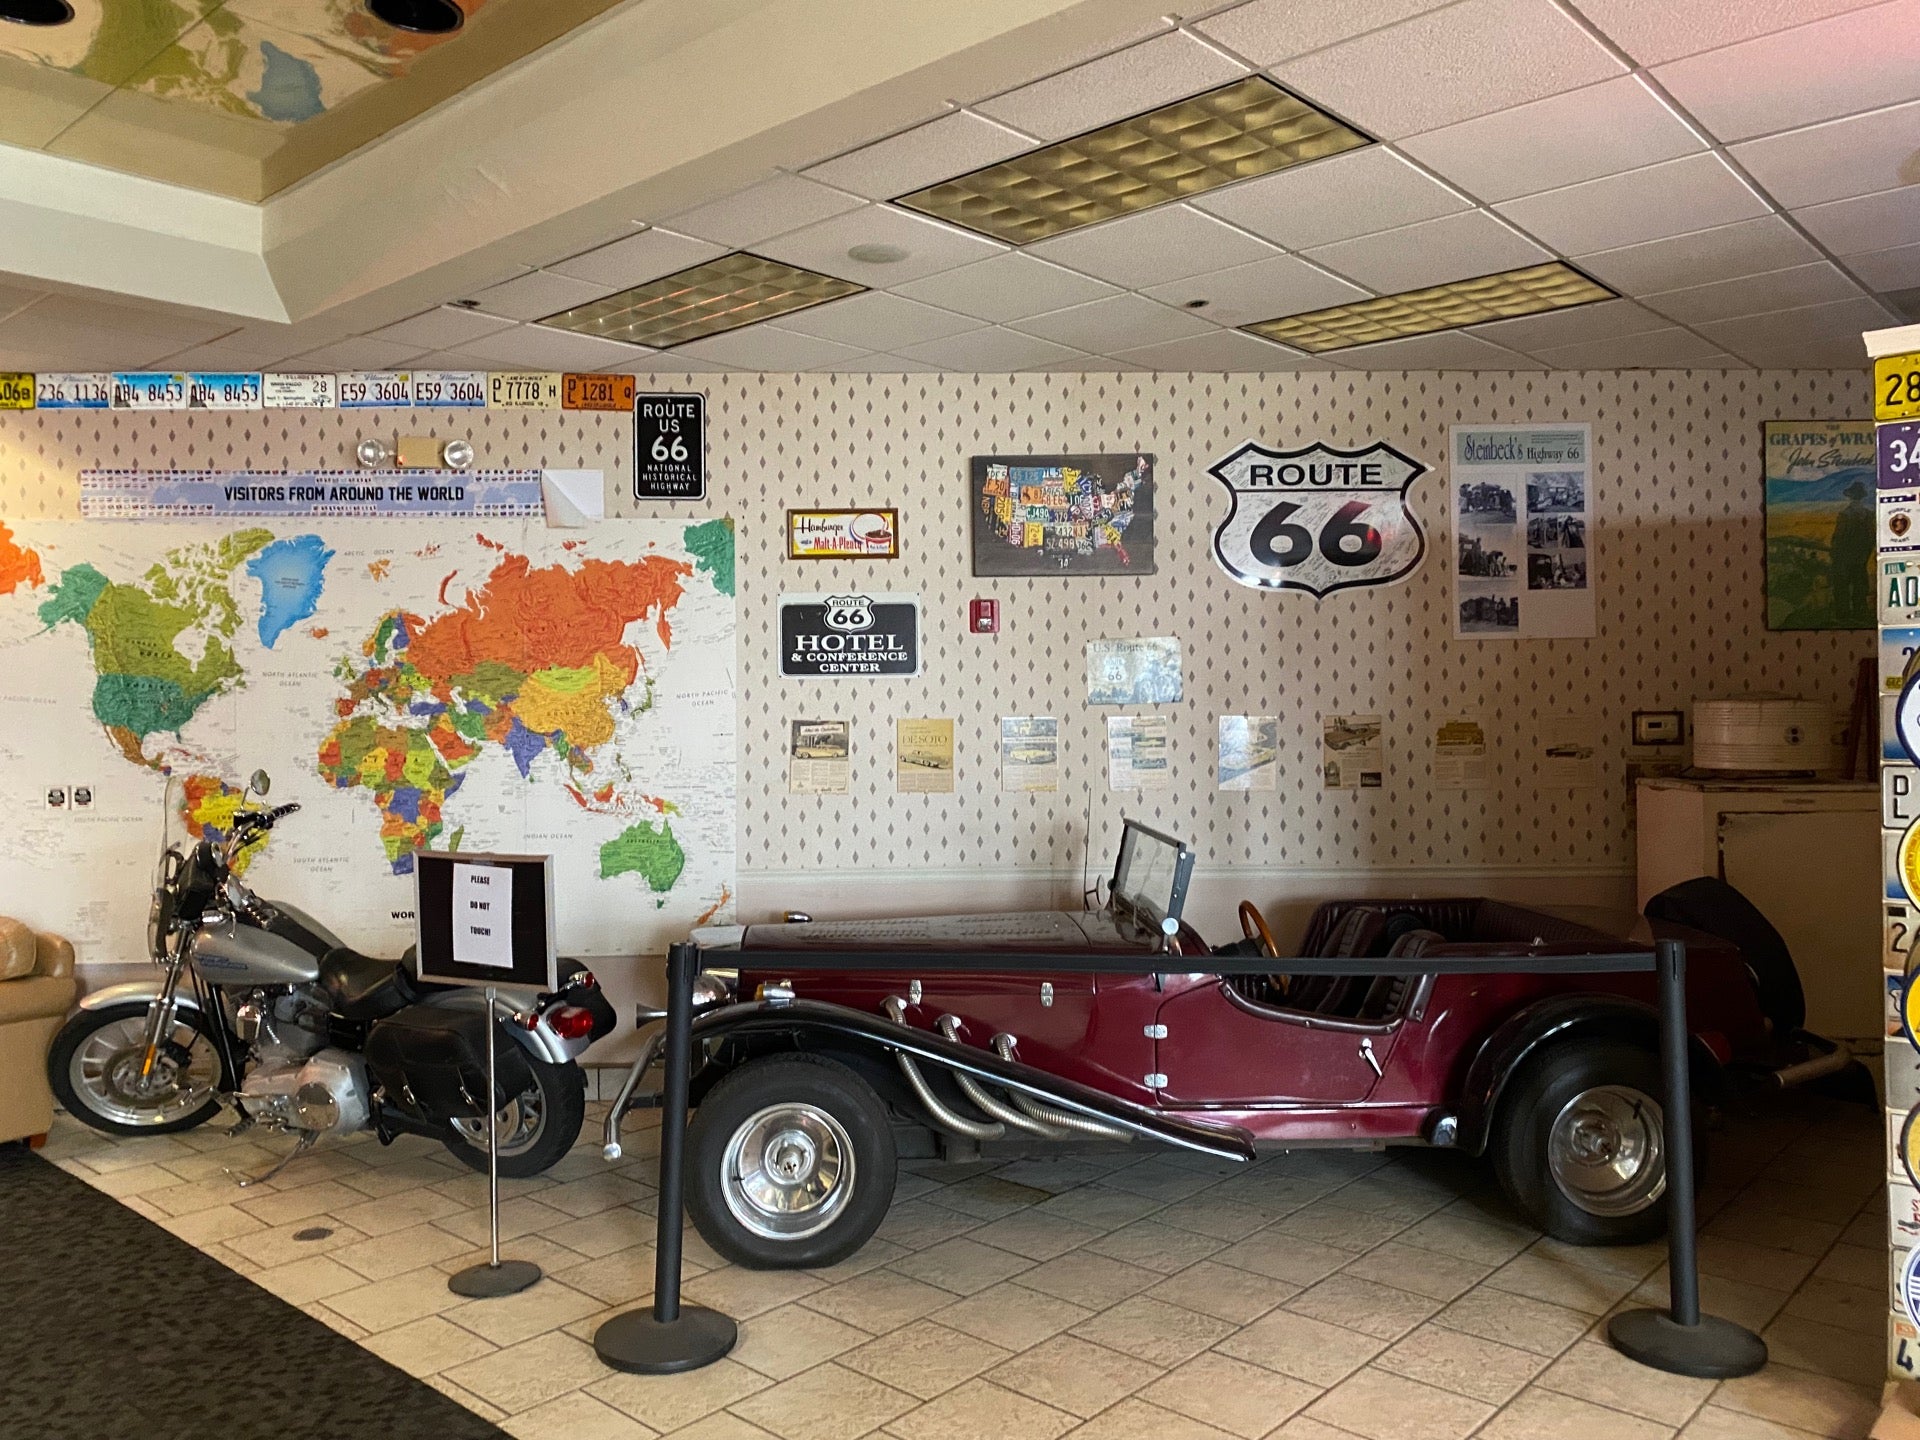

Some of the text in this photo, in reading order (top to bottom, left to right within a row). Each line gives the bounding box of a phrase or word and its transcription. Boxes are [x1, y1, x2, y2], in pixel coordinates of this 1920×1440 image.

[0, 382, 30, 401] 06B
[38, 383, 108, 401] 236 1136
[148, 384, 182, 401] 8453
[224, 384, 257, 401] 8453
[312, 380, 327, 392] 28
[341, 382, 408, 400] E59 3604
[416, 382, 483, 400] E59 3604
[506, 381, 539, 400] 7778
[549, 384, 556, 398] H
[582, 382, 614, 401] 1281
[643, 403, 695, 418] ROUTE
[659, 418, 680, 433] US
[1769, 433, 1827, 445] GRAPES
[1840, 433, 1876, 445] WRA
[651, 435, 688, 462] 66
[1464, 434, 1523, 460] Steinbeck's
[1527, 447, 1563, 464] Highway
[1567, 447, 1580, 459] 66
[647, 464, 691, 472] NATIONAL
[1250, 464, 1382, 486] ROUTE
[642, 473, 697, 481] HISTORICAL
[224, 486, 464, 501] VISITORS FROM AROUND THE WORLD
[650, 482, 690, 490] HIGHWAY
[1250, 501, 1382, 567] 66
[833, 609, 864, 625] 66
[795, 634, 903, 651] HOTEL
[791, 652, 908, 662] & CONFERENCE
[819, 663, 880, 672] CENTER
[1108, 670, 1121, 681] 66
[470, 875, 490, 885] PLEASE
[470, 901, 490, 911] DO NOT
[391, 911, 415, 919] WOR
[470, 926, 491, 936] TOUCH!
